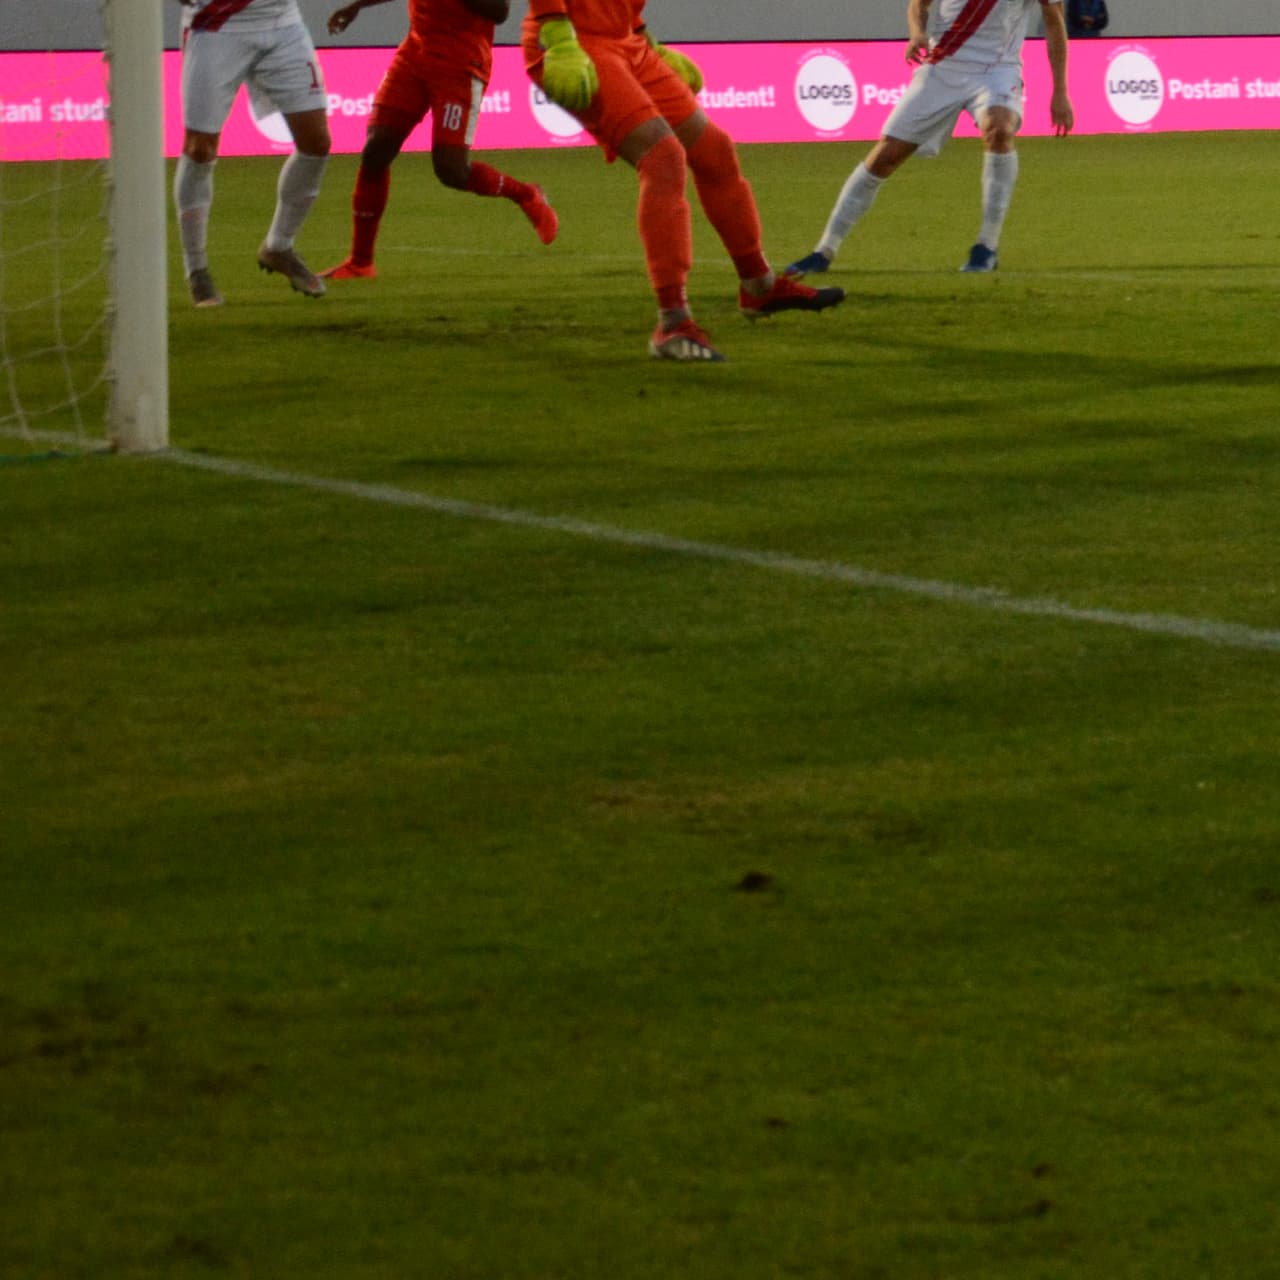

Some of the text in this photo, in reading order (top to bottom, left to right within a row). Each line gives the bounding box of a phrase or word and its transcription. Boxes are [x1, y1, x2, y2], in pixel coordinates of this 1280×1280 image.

[800, 85, 851, 99] LOGOS
[1109, 80, 1158, 94] LOGOS
[1168, 77, 1240, 100] Postani
[442, 102, 463, 132] 18
